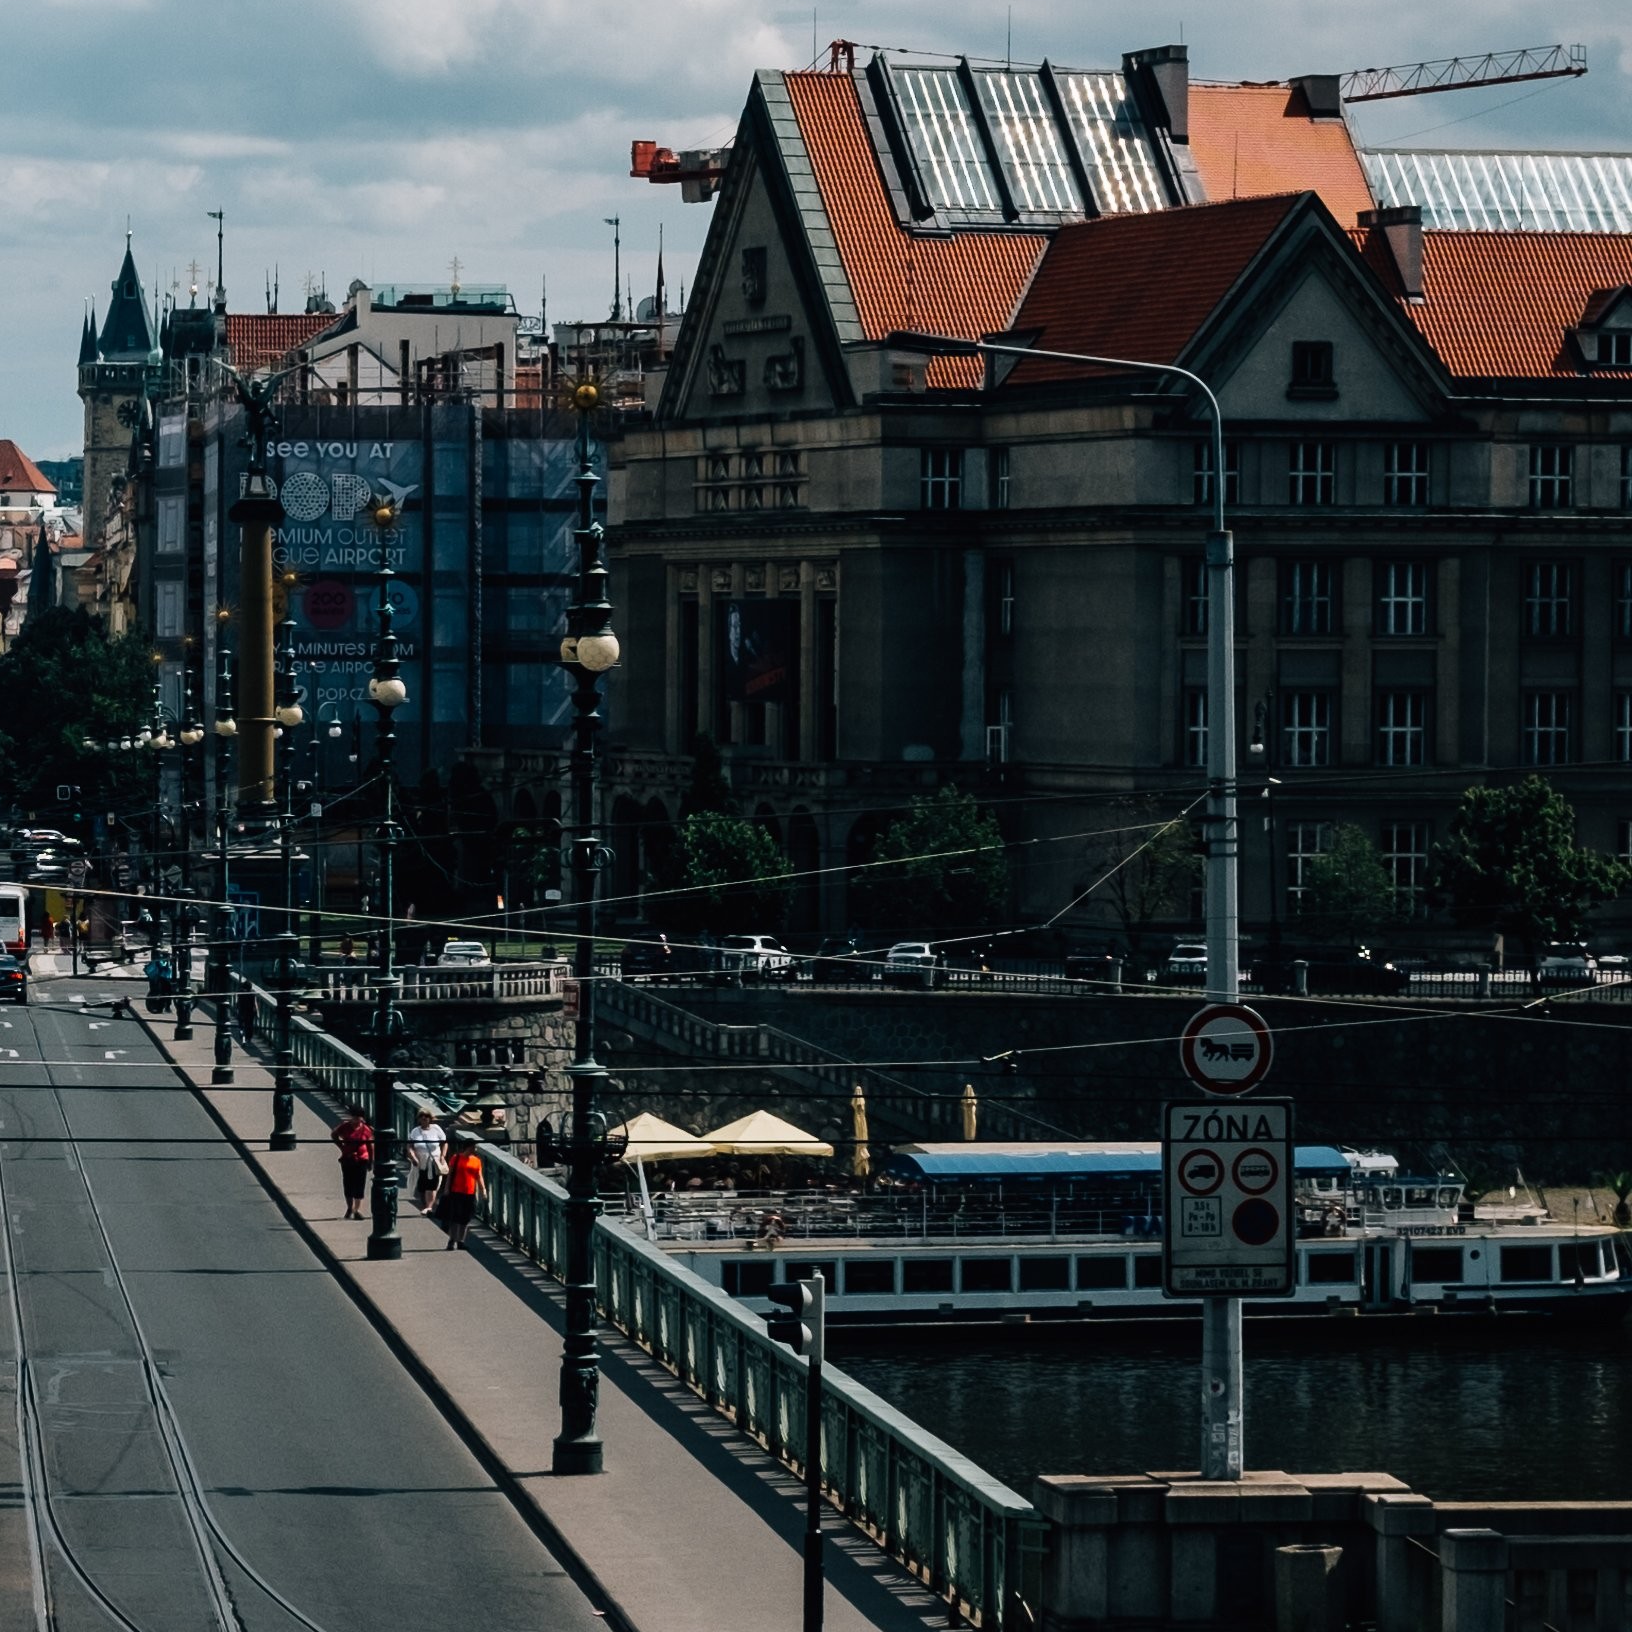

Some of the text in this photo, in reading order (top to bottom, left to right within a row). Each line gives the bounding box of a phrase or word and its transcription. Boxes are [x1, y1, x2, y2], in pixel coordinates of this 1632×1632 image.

[315, 442, 358, 458] YOU
[369, 442, 394, 458] AT
[240, 528, 332, 545] MIUM
[312, 592, 345, 605] 200
[370, 642, 414, 656] FM
[330, 661, 376, 674] AIRPO
[317, 687, 366, 701] POP.CZ
[1183, 1108, 1273, 1141] ZÓNA
